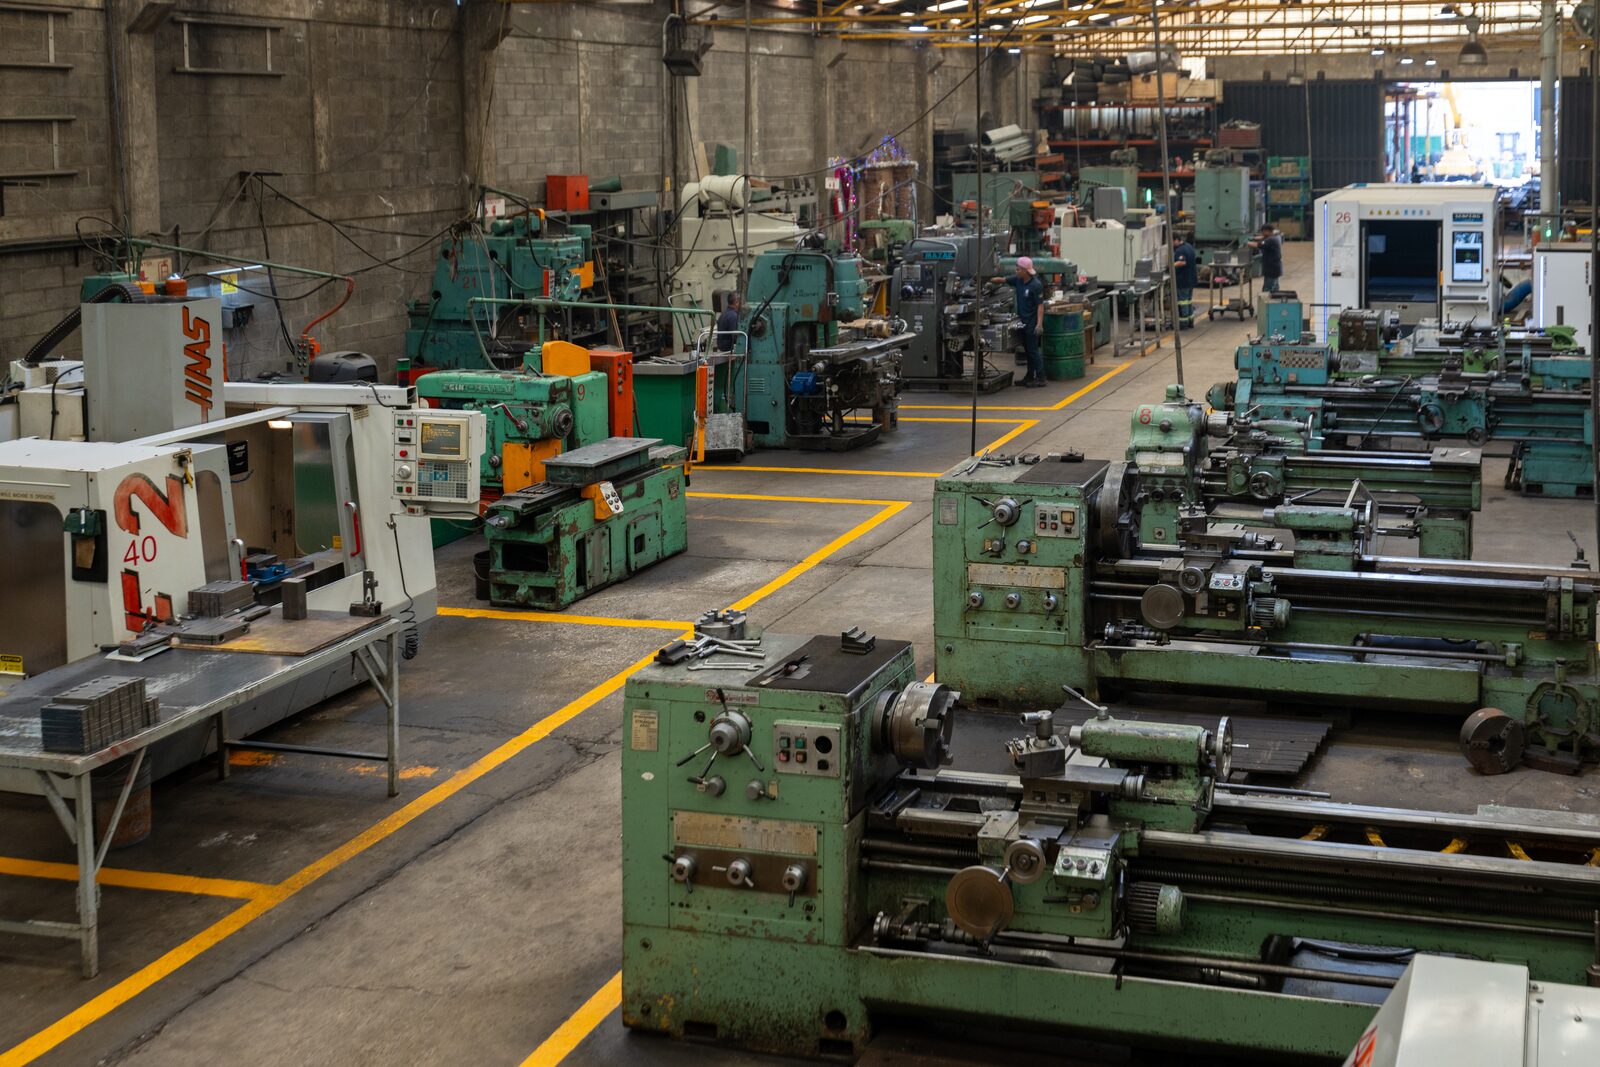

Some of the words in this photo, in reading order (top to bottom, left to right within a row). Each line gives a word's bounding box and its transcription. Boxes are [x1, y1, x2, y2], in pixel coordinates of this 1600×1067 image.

[1336, 211, 1351, 223] 26
[462, 274, 477, 289] 21
[182, 305, 213, 424] HAAS
[577, 383, 585, 401] 9
[1139, 408, 1151, 425] 8
[123, 535, 157, 566] 40
